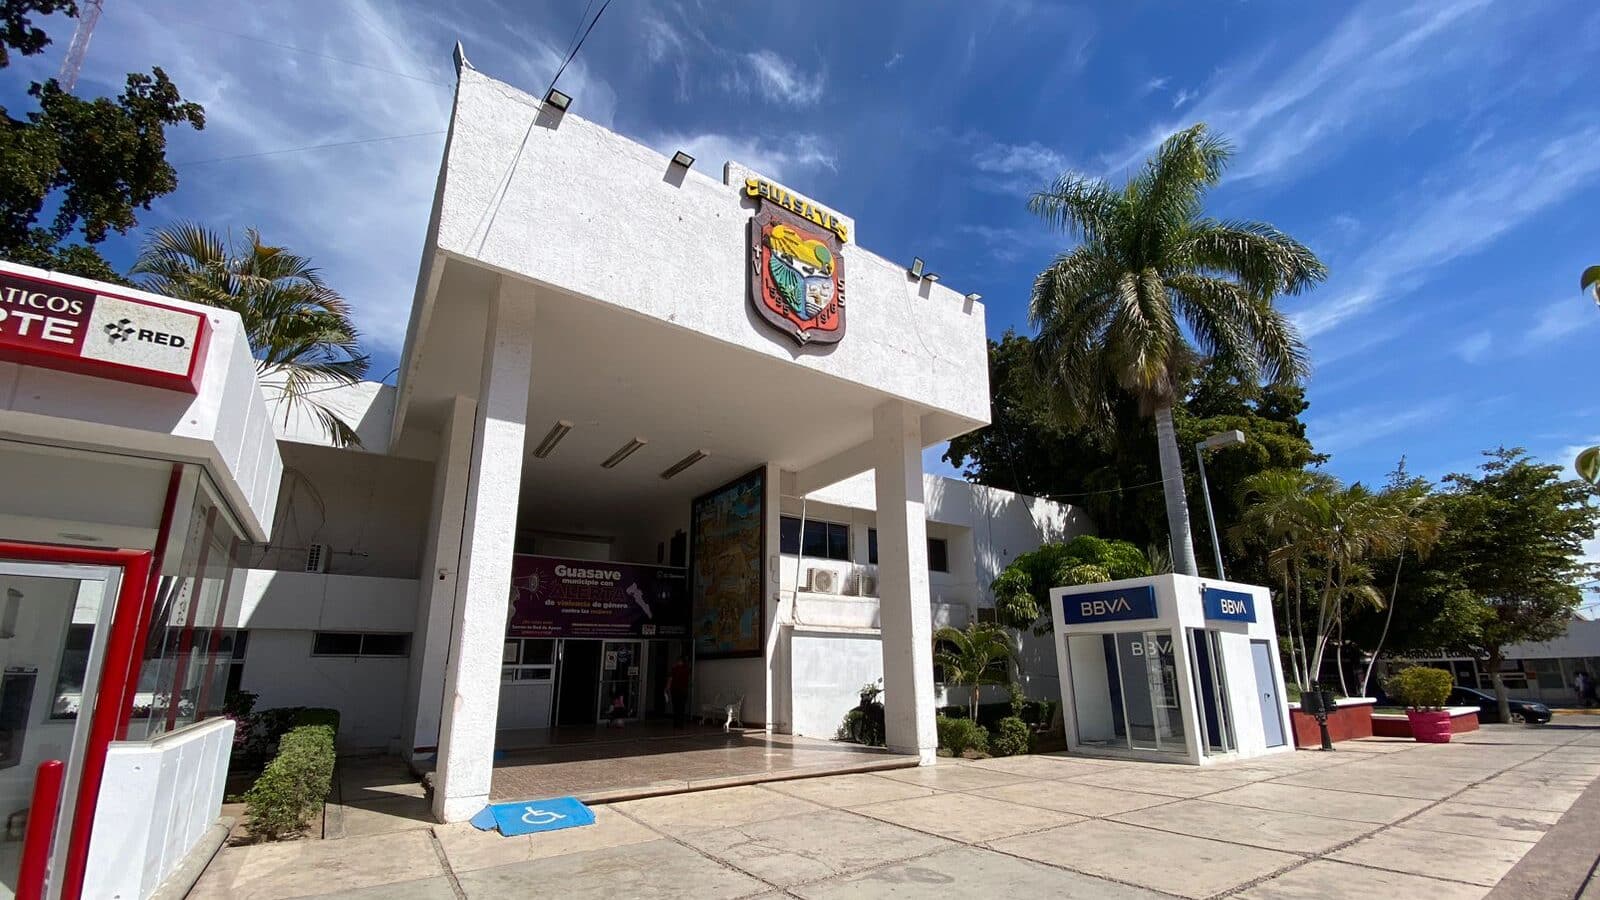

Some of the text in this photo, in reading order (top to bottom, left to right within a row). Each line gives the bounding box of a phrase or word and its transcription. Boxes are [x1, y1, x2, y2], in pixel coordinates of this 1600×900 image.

[758, 181, 839, 230] GUASAVE
[0, 307, 79, 345] TE
[137, 328, 186, 349] RED
[554, 564, 622, 581] Guasave
[562, 578, 599, 586] municipio
[545, 598, 555, 606] de
[592, 600, 602, 608] de
[1080, 597, 1132, 617] BBVA
[1220, 598, 1247, 615] BBVA
